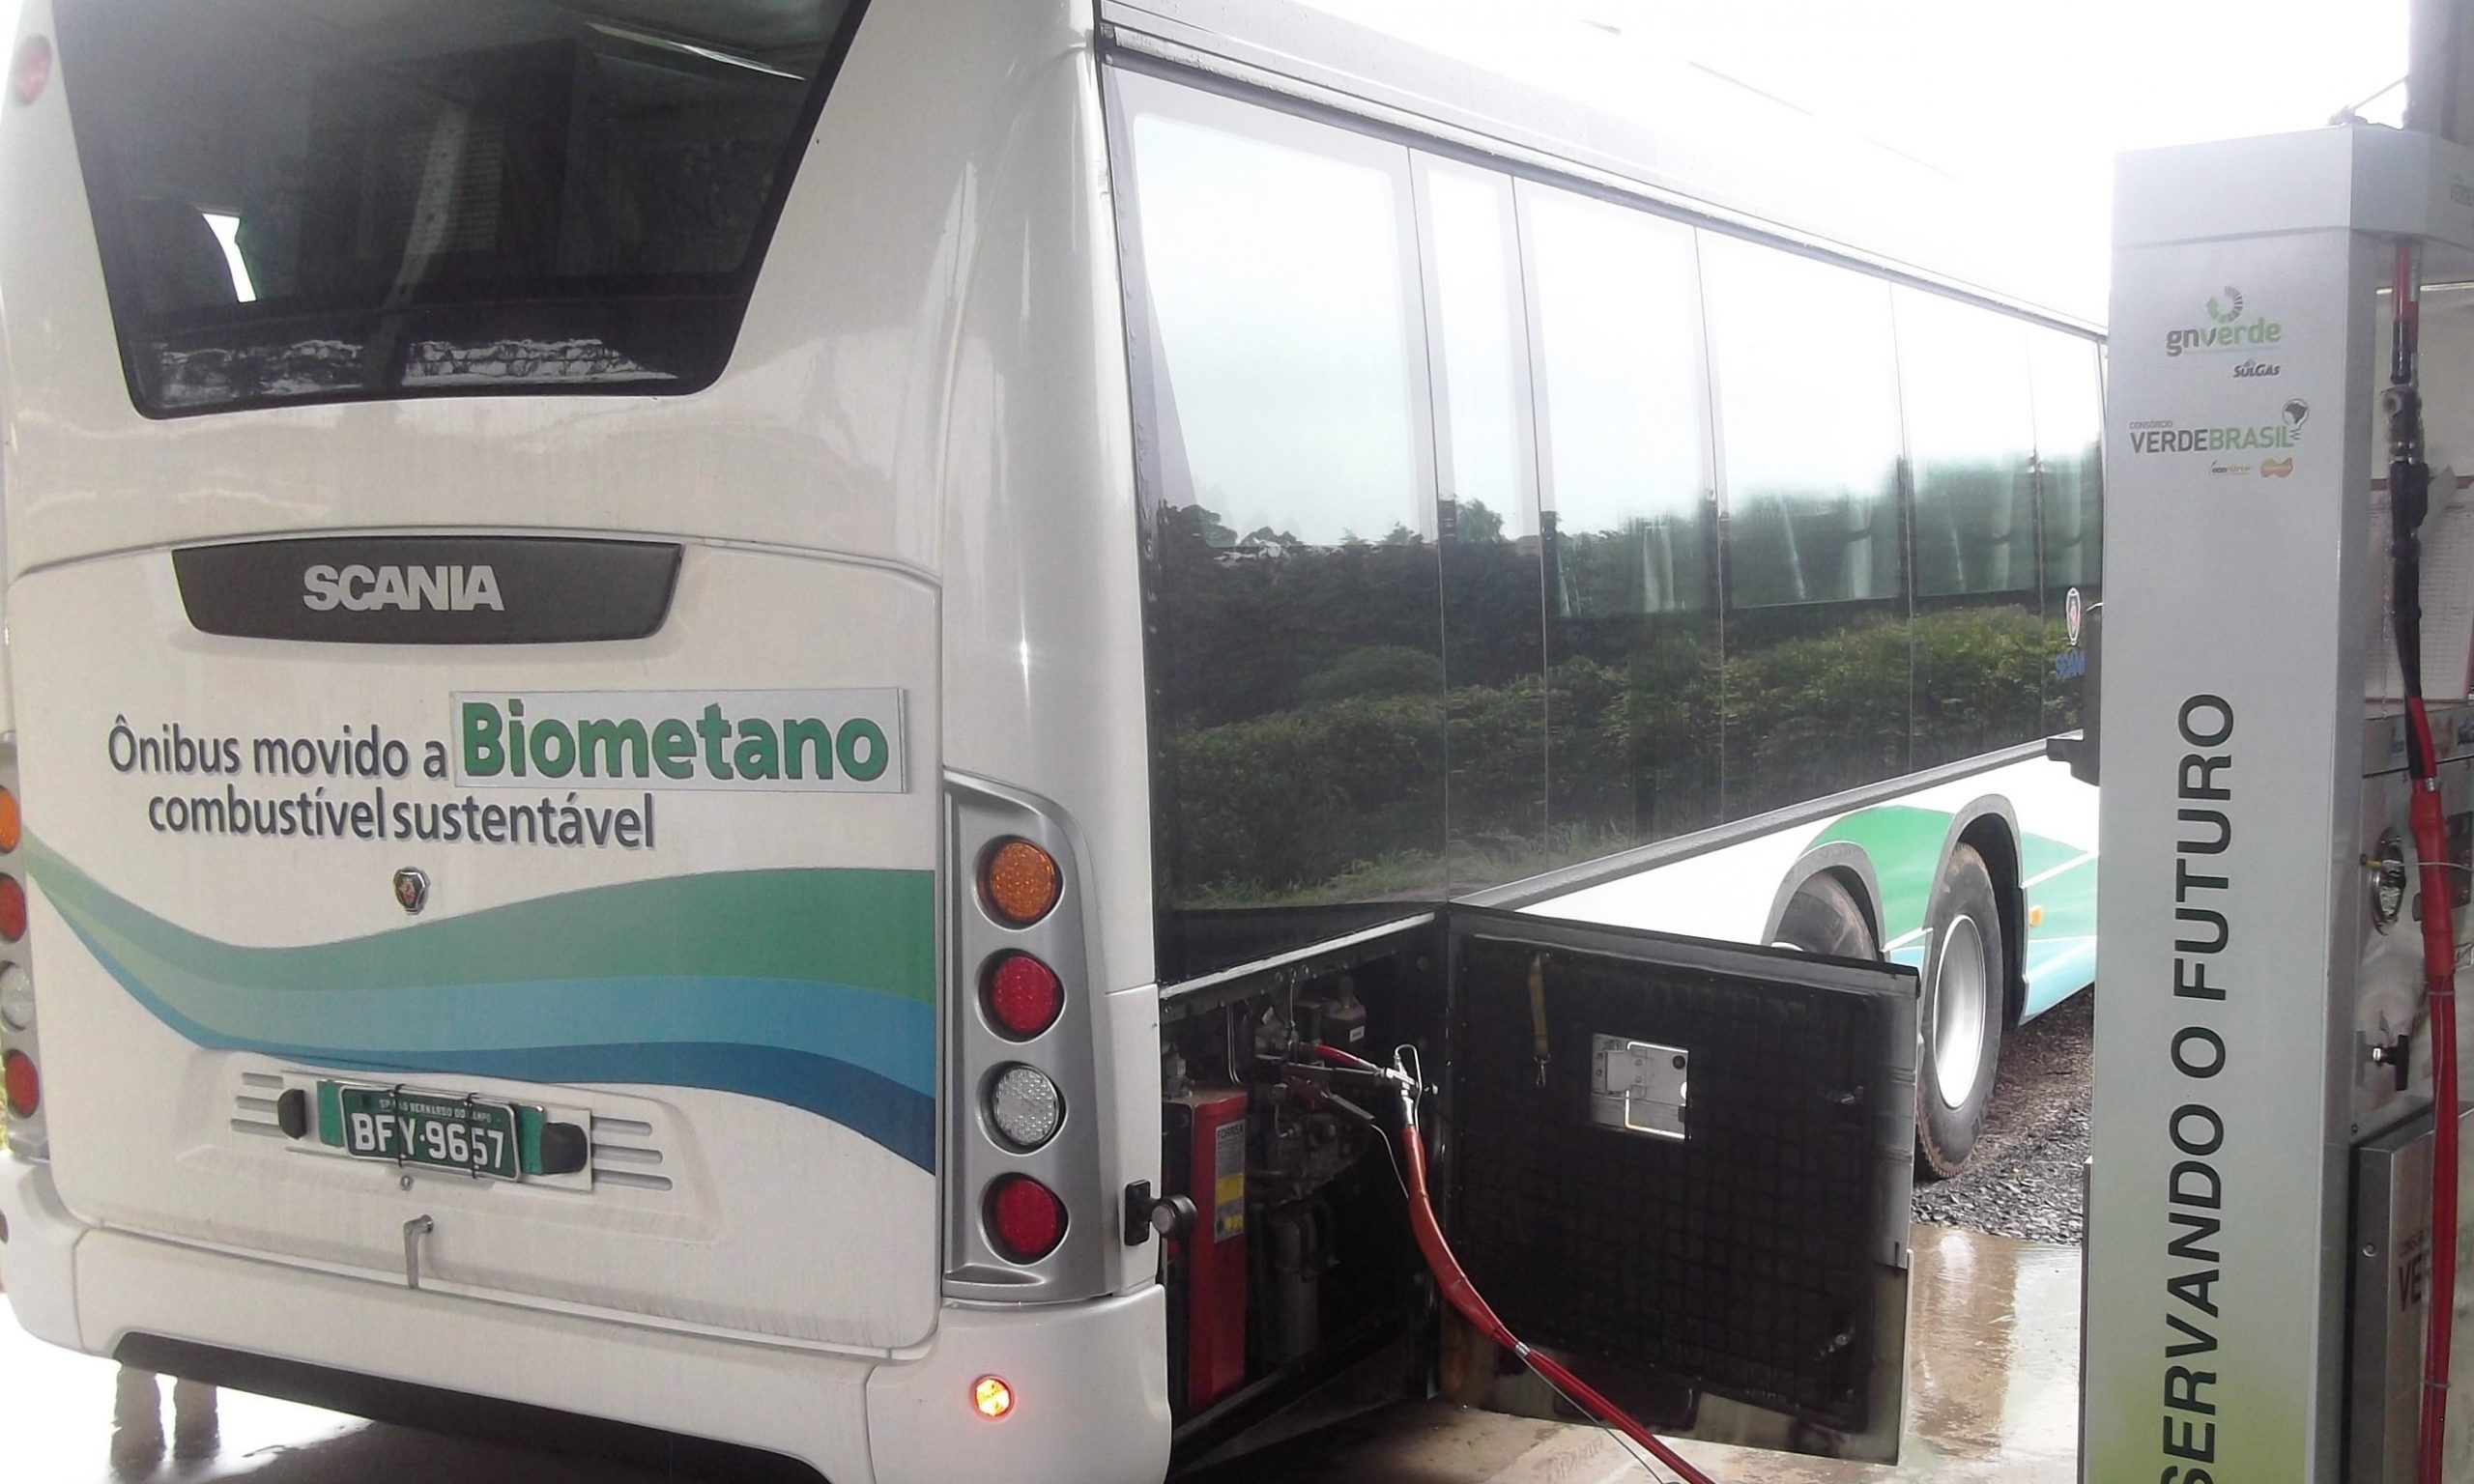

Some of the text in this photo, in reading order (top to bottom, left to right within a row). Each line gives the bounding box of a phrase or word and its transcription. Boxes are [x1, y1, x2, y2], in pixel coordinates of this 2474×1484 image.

[2166, 318, 2281, 357] gnverde
[2130, 425, 2294, 453] VERDEBRASIL
[302, 564, 504, 611] SCANIA
[107, 698, 888, 782] Ônibus movido a Biometano
[148, 786, 654, 849] combustível sustentável
[2173, 694, 2234, 1002] FUTURO
[2171, 1026, 2227, 1079] O
